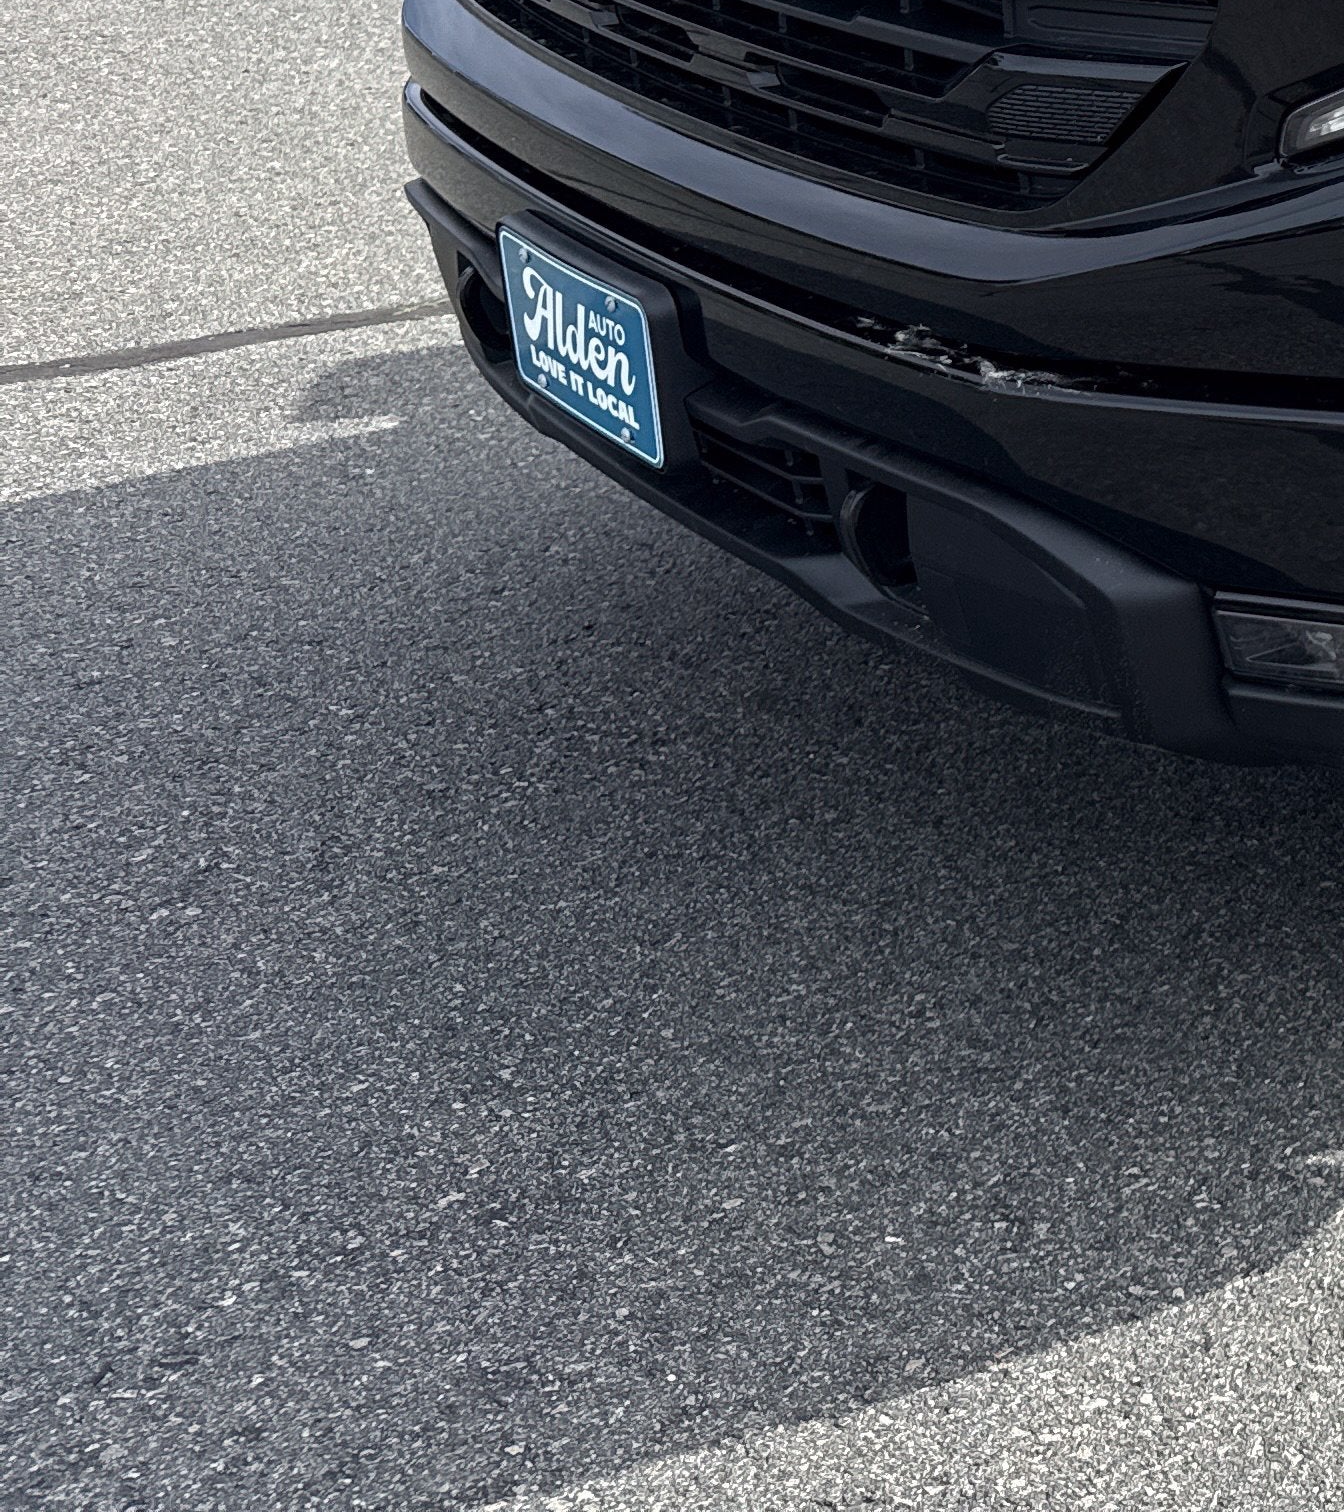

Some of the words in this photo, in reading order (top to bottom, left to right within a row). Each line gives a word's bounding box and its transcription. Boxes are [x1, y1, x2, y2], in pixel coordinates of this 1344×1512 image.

[522, 266, 636, 395] Alden
[588, 310, 626, 345] AUTO
[530, 344, 567, 386] LOVE
[569, 369, 585, 396] IT
[587, 380, 640, 430] LOCAL
